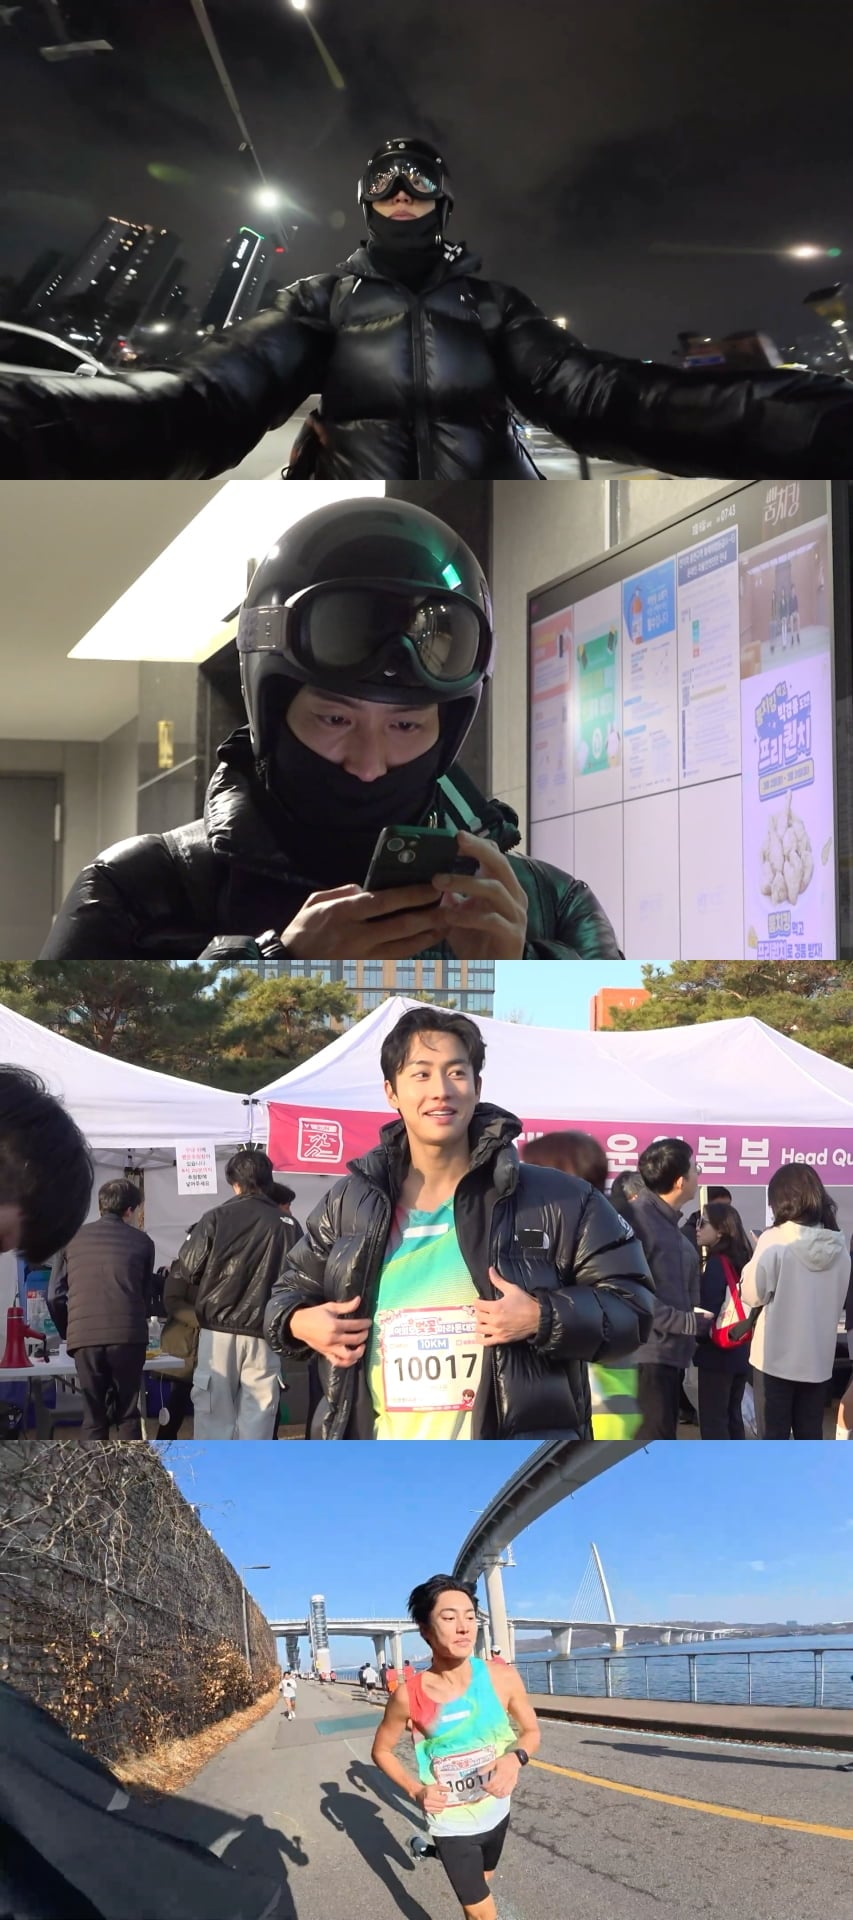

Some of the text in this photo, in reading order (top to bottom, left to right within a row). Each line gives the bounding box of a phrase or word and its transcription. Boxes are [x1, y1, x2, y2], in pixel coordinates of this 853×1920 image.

[781, 1148, 828, 1166] Head
[832, 1148, 853, 1167] Qu
[421, 1340, 447, 1349] 10KM
[394, 1353, 477, 1381] 10017
